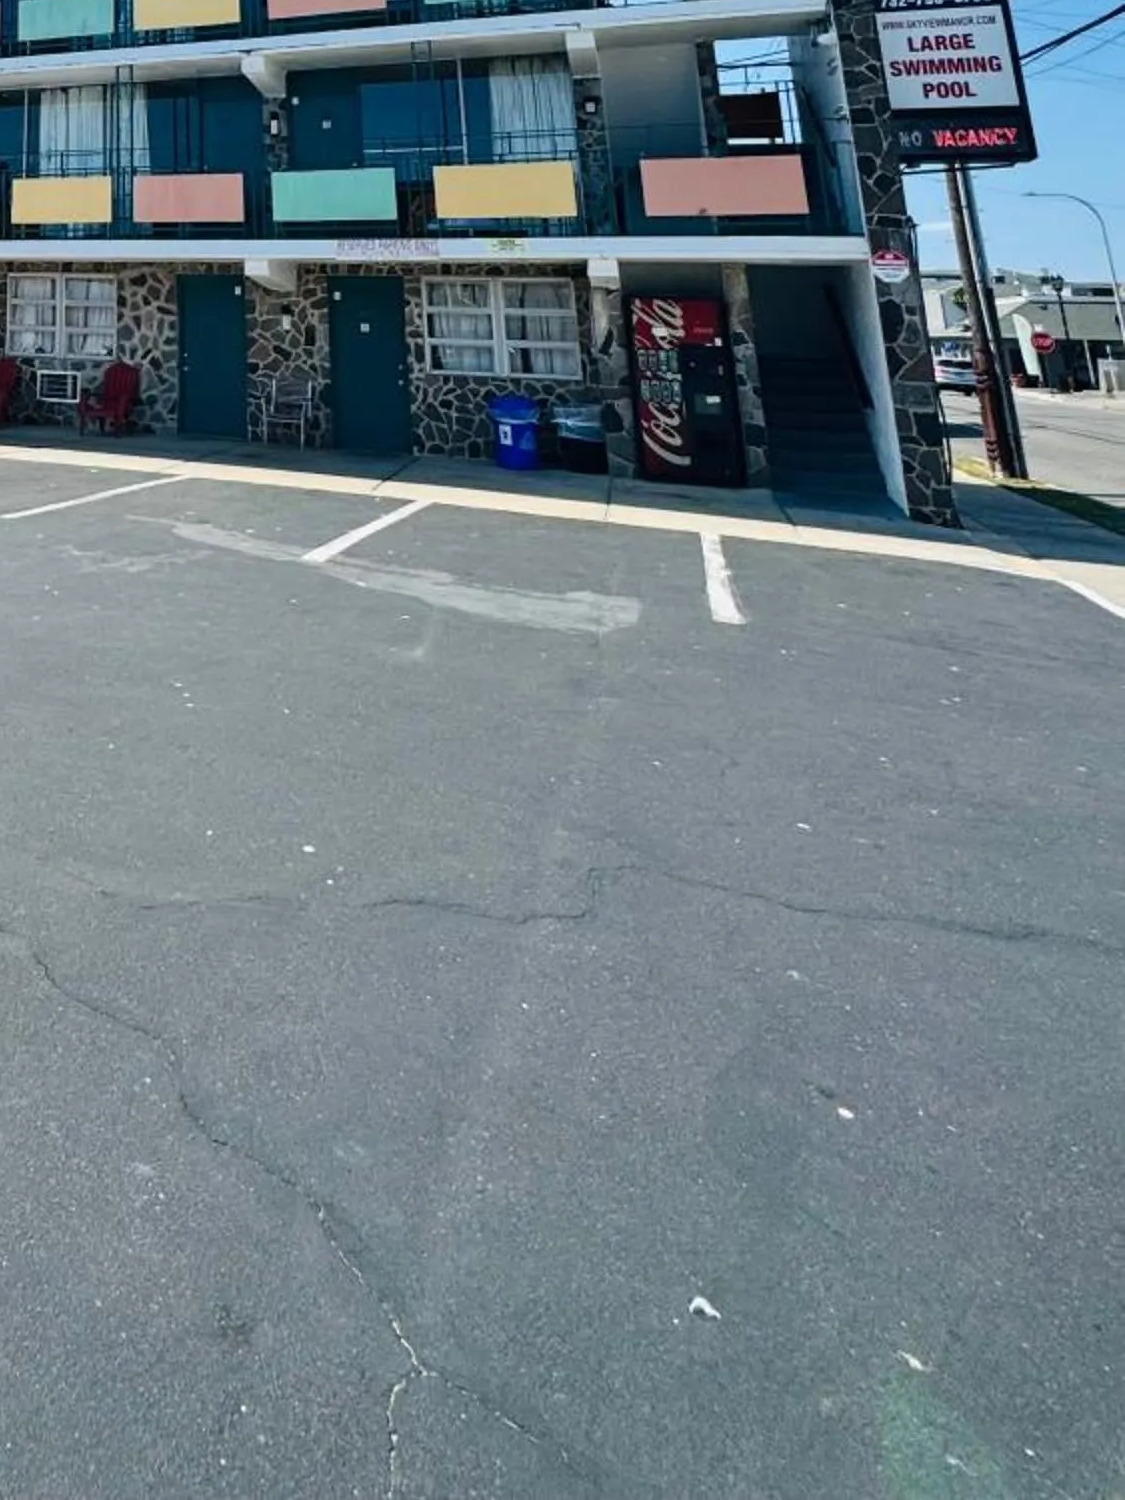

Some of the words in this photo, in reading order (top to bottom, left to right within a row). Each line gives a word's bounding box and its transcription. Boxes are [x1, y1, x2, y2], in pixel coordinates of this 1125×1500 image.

[907, 33, 976, 52] LARGE
[889, 55, 1002, 77] SWIMMING
[922, 81, 978, 99] POOL
[899, 130, 922, 147] NO
[932, 127, 1018, 148] VACANCY
